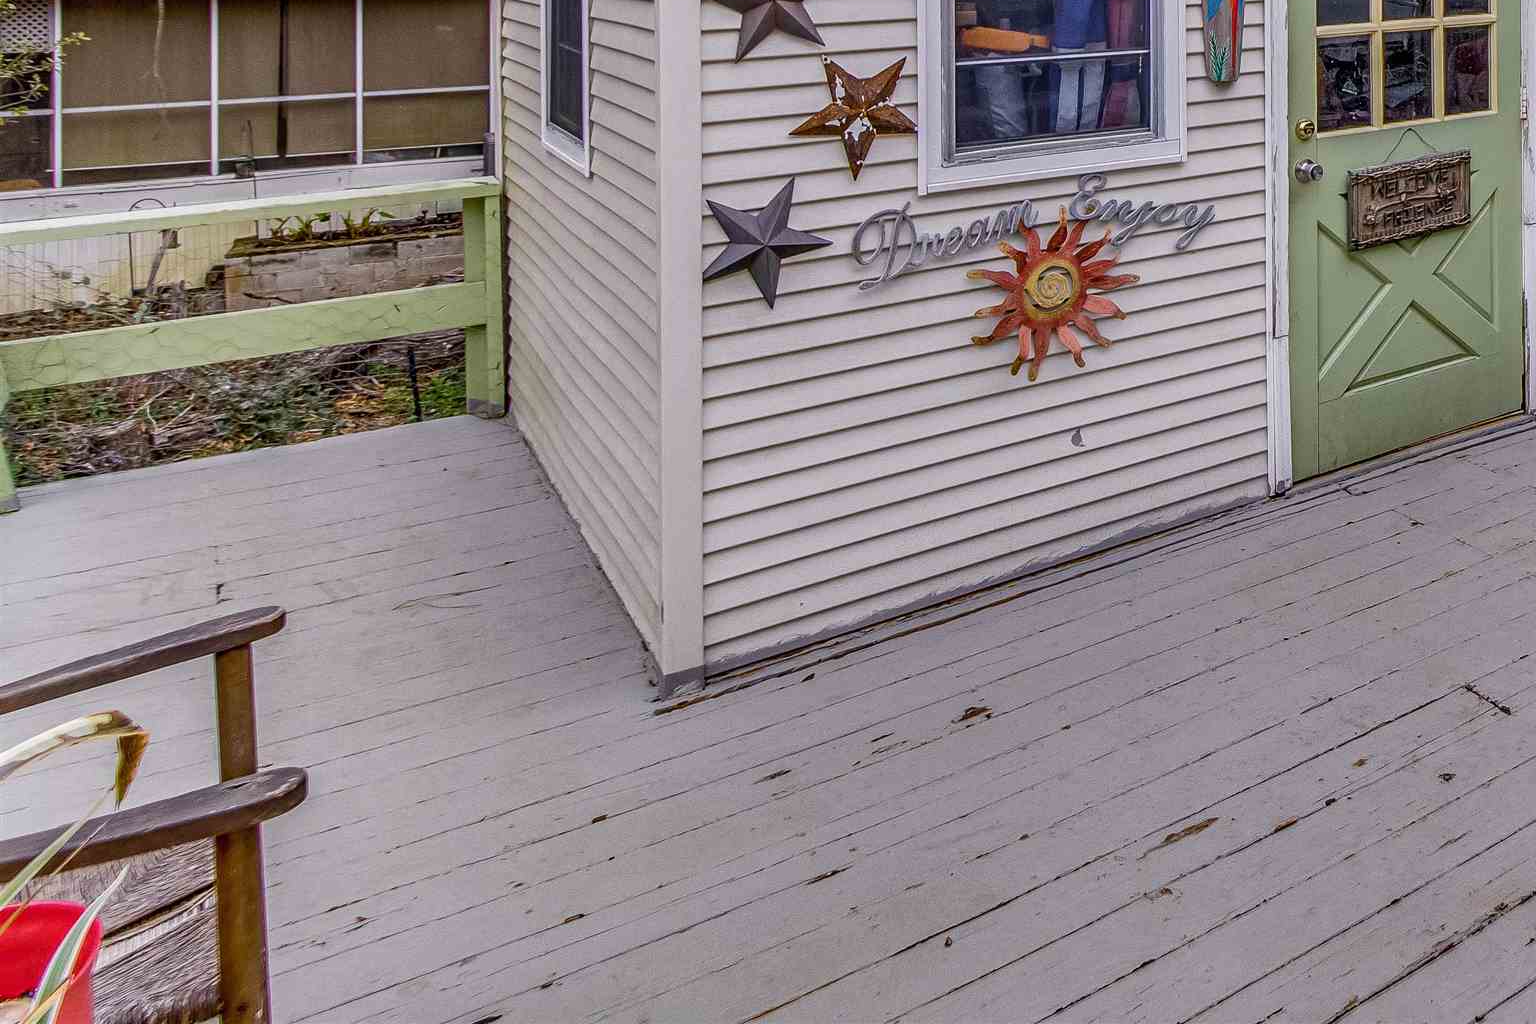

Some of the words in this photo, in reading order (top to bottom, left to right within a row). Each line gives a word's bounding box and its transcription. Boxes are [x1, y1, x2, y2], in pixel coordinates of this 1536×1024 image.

[1069, 174, 1216, 251] Enjoy
[1370, 167, 1455, 199] WELCOME
[852, 201, 1039, 291] Dream
